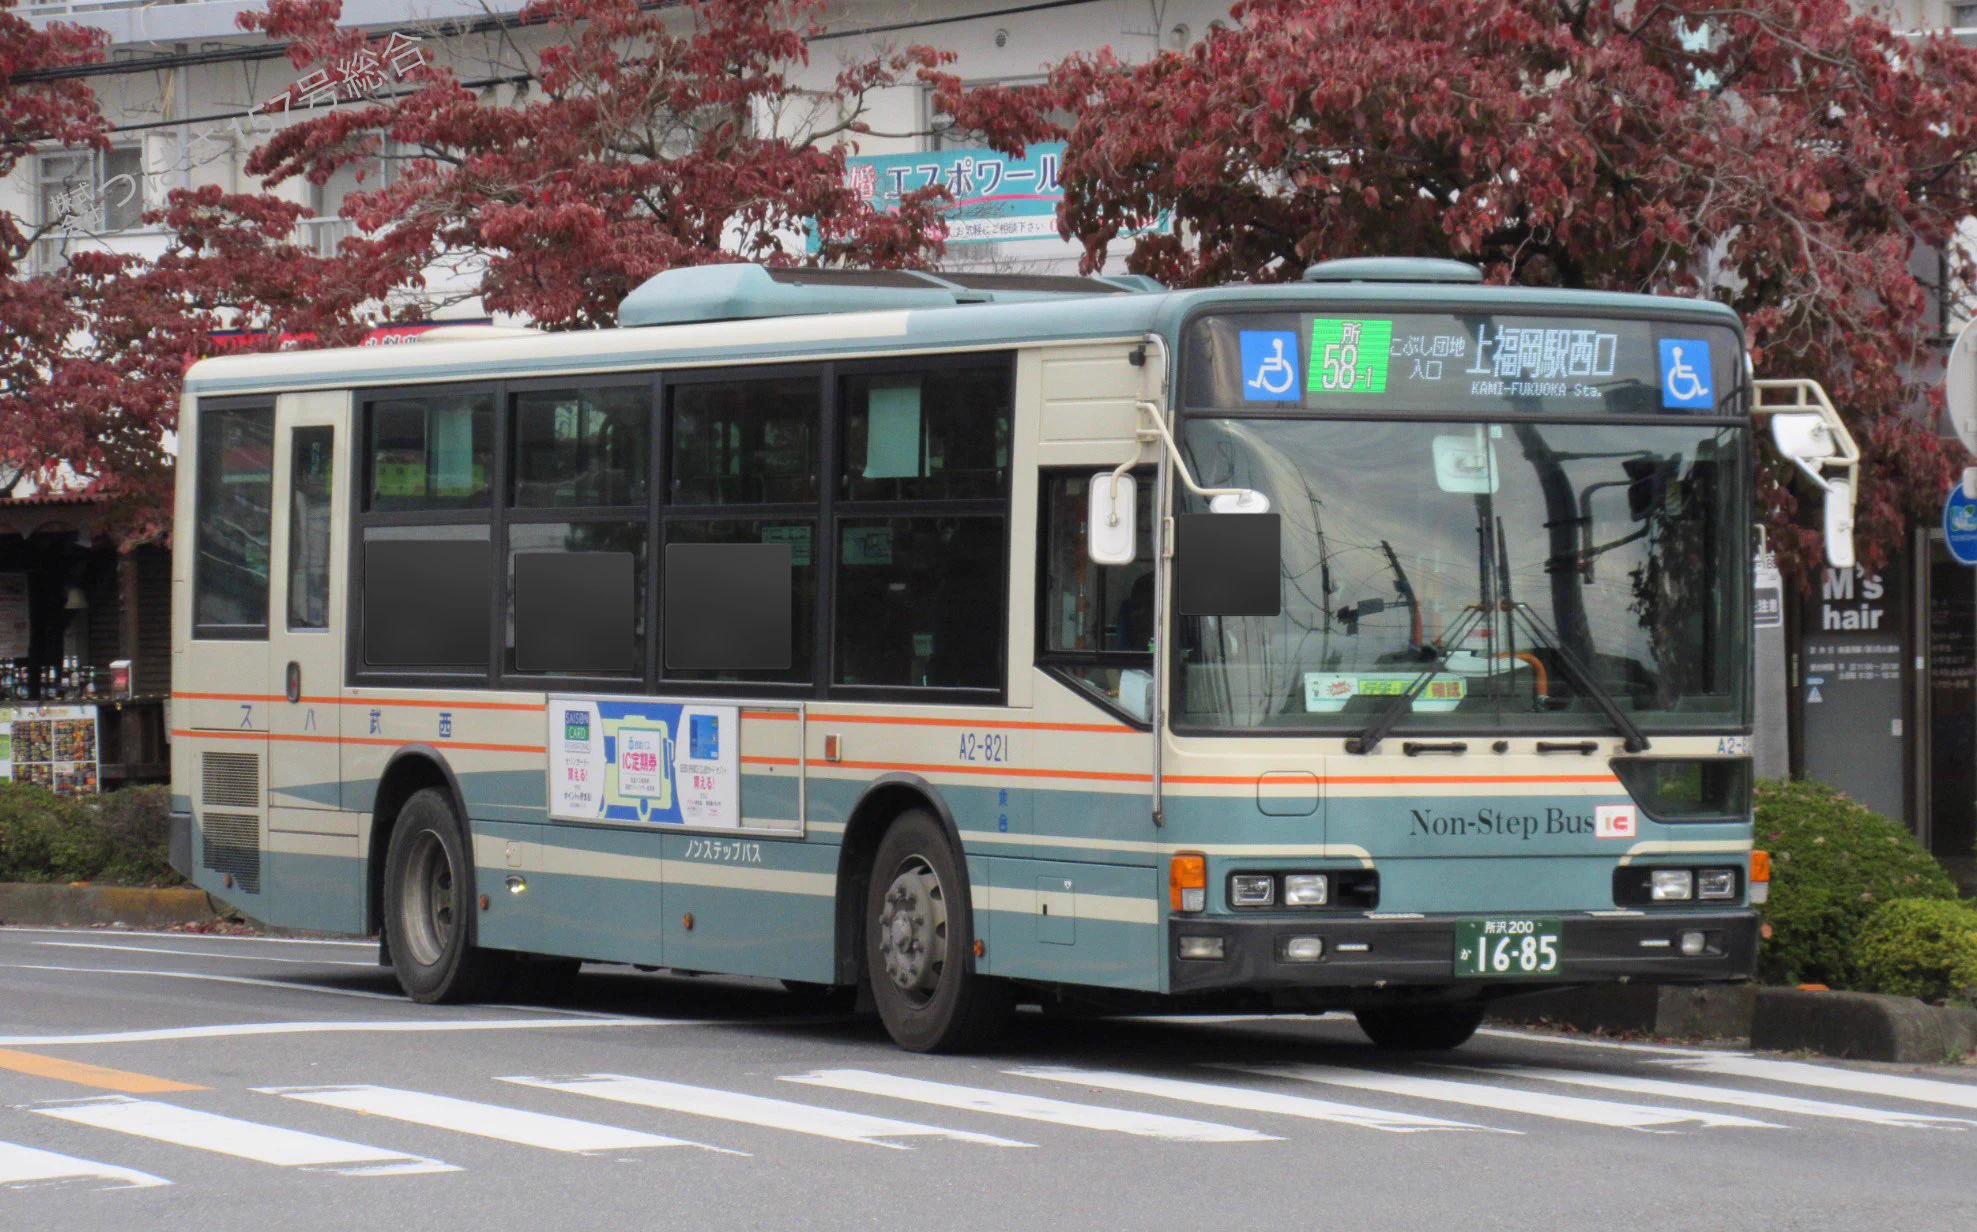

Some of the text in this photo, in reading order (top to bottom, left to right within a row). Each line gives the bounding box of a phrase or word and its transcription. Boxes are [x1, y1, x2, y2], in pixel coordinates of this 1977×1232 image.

[1390, 335, 1465, 357] こぶし団地
[1465, 324, 1618, 378] 上福岡駅西口
[1409, 358, 1443, 380] 入口
[1471, 381, 1602, 397] KAMI-FUKUOKA Sta.
[1823, 604, 1884, 630] hair
[959, 733, 1008, 761] A2-821
[622, 752, 657, 772] IC定期券
[1410, 807, 1594, 840] Non-Step Bus
[685, 840, 761, 862] ノンステップバス
[1479, 936, 1557, 972] 16-85
